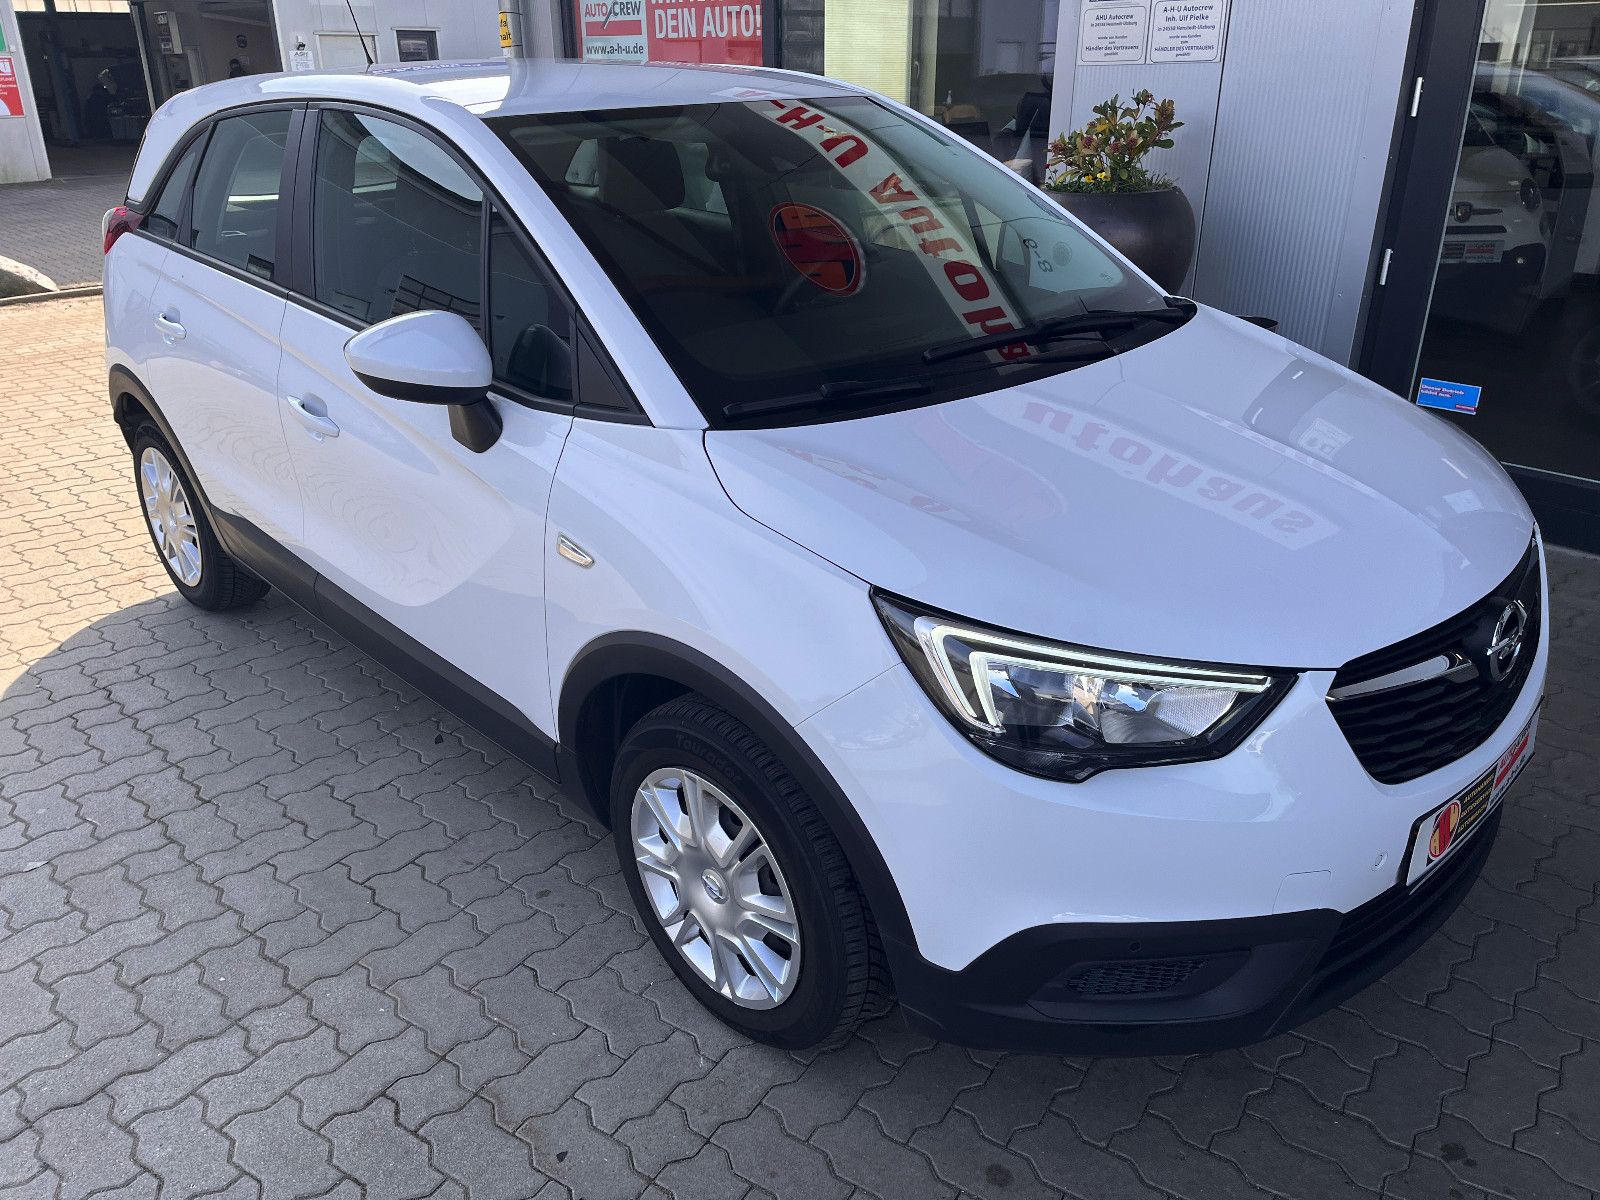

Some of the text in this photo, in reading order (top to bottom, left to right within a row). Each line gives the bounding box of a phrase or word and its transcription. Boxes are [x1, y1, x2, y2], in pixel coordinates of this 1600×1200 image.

[654, 4, 762, 39] DEIN AUTO!
[1189, 13, 1210, 21] Pielke
[585, 43, 644, 55] www.a-h-u.de
